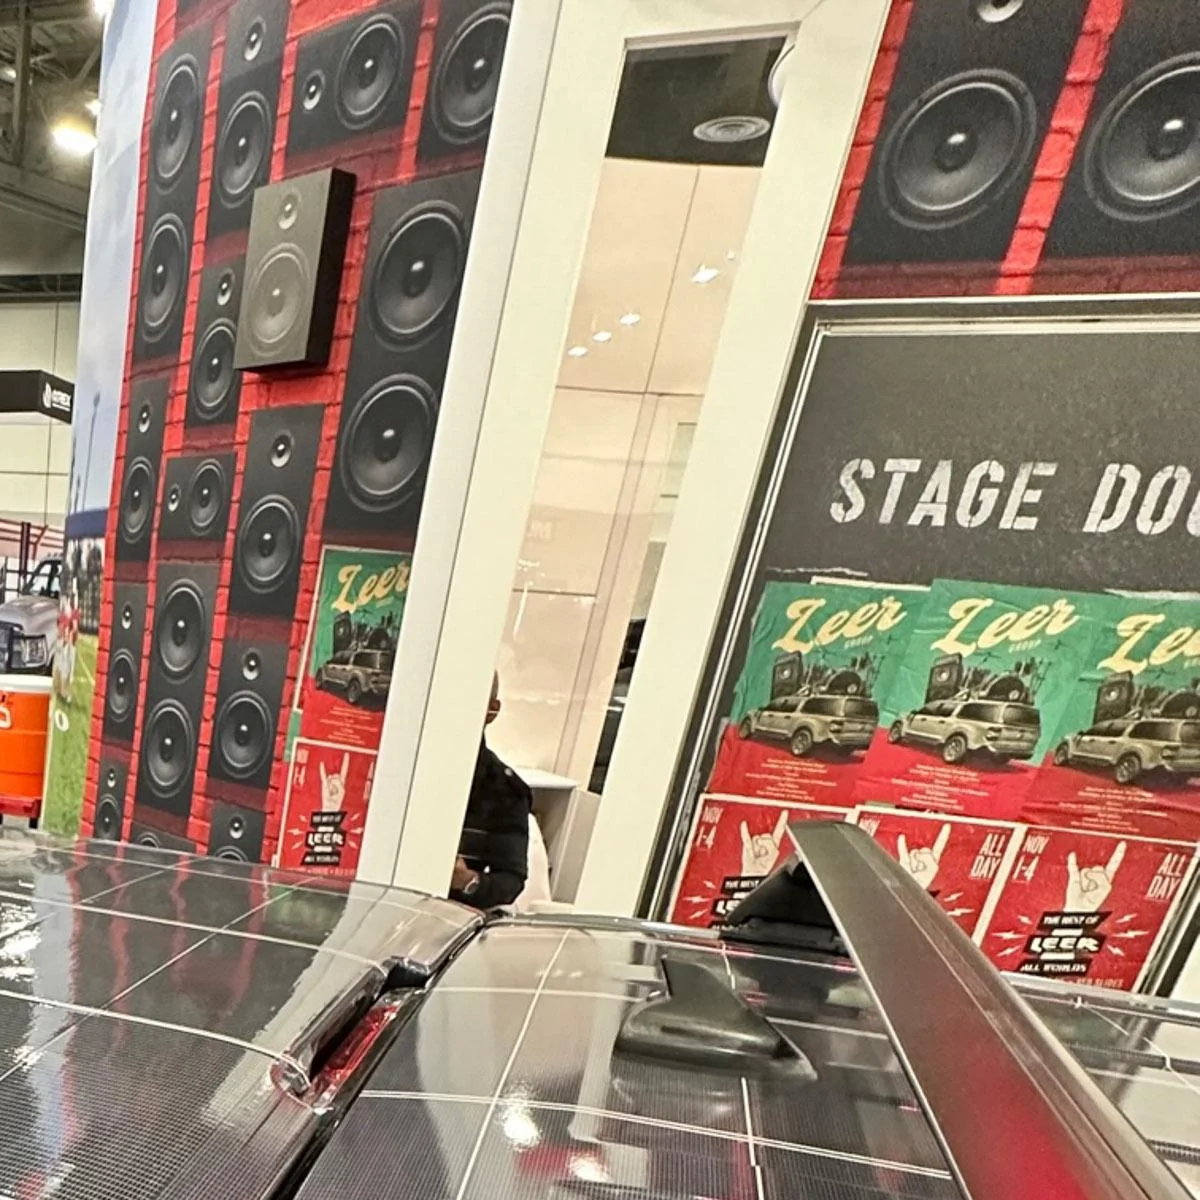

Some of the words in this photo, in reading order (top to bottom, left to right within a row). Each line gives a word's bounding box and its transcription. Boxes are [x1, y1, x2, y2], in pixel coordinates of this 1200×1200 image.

[830, 458, 1058, 531] STAGE
[1082, 463, 1200, 538] DO
[330, 562, 409, 614] Leer
[771, 596, 907, 654] Leer
[931, 599, 1080, 657] Leer
[702, 805, 723, 824] NOV
[696, 824, 716, 850] 1-4
[980, 833, 1006, 856] ALL
[1022, 834, 1050, 854] NOV
[970, 855, 1000, 879] DAY
[1013, 855, 1039, 881] 1-4
[1157, 852, 1187, 876] ALL
[1147, 878, 1181, 899] DAY
[1030, 937, 1099, 953] LEER
[1020, 963, 1040, 973] ALL
